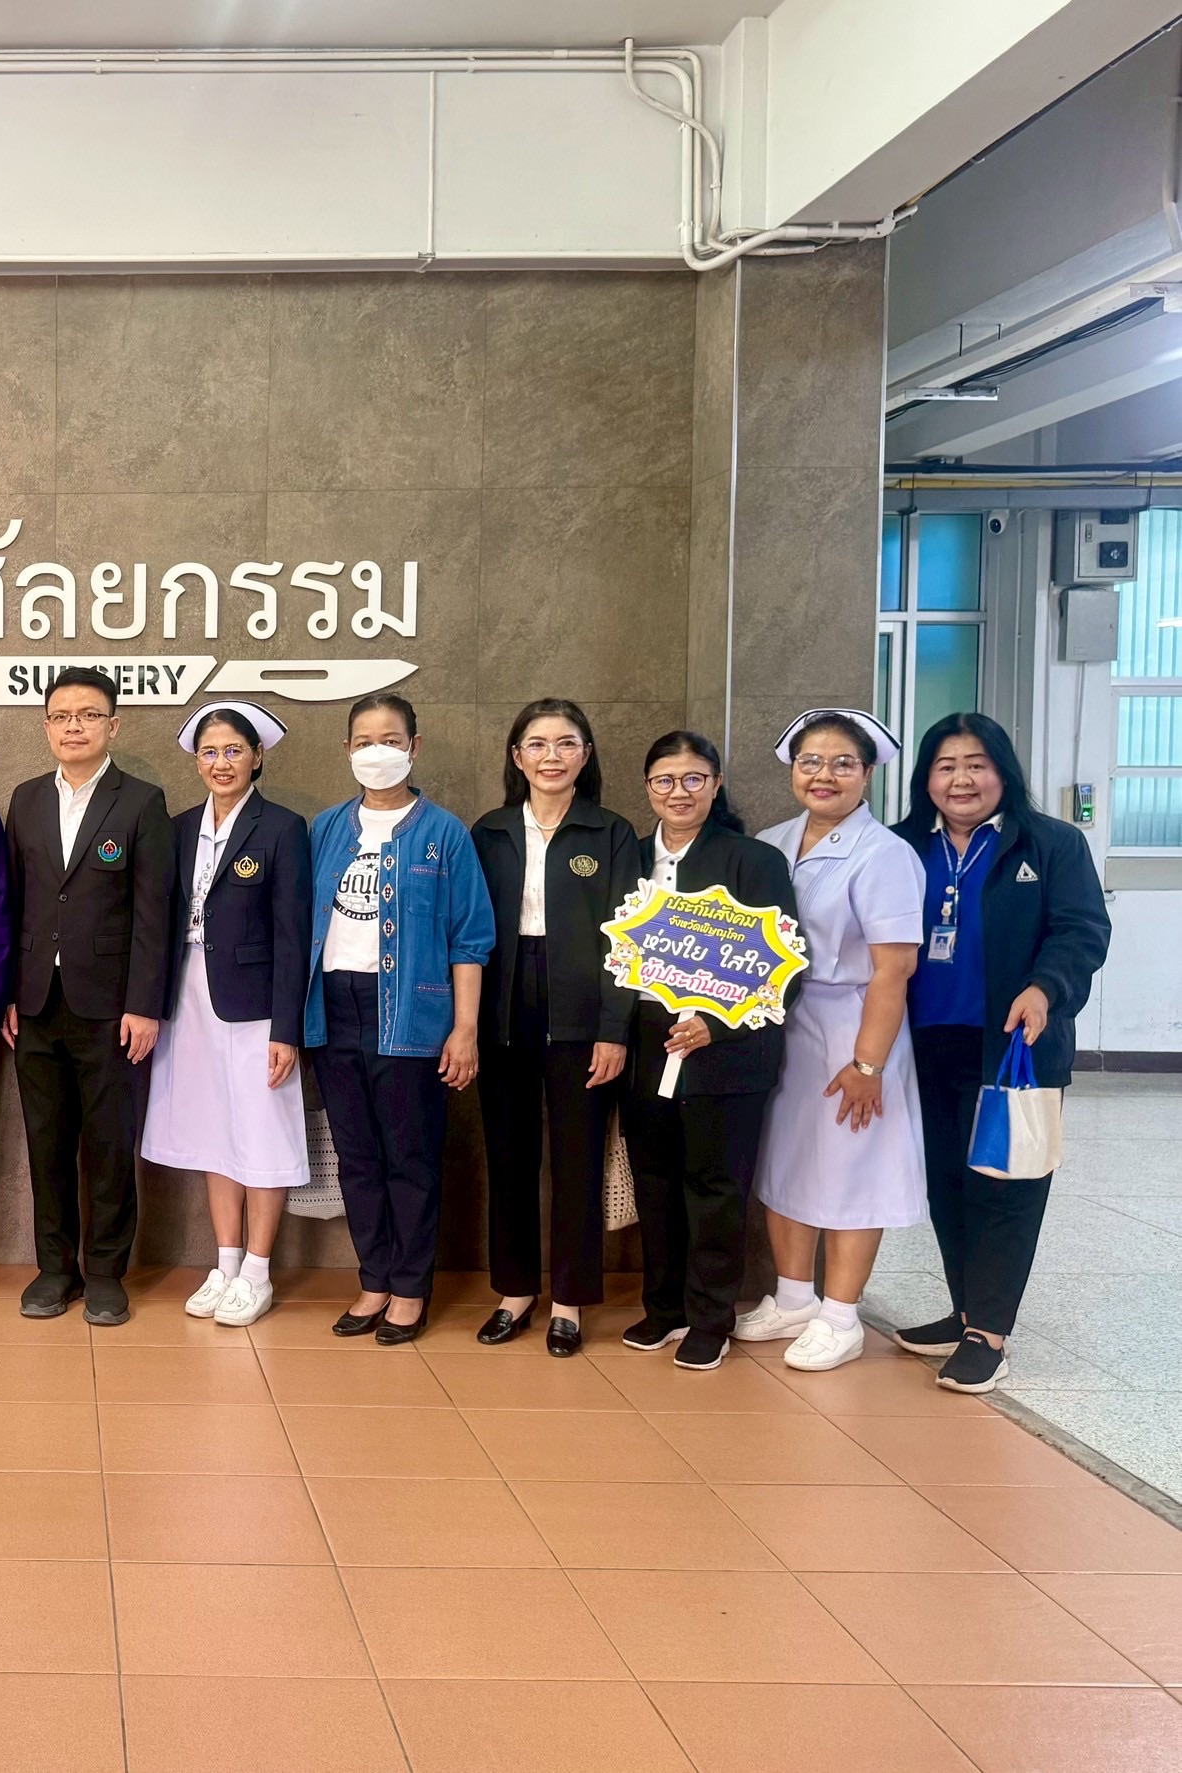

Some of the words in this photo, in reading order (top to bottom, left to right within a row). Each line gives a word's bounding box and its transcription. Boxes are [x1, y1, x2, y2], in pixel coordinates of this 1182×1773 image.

[8, 664, 186, 696] SUERY
[666, 896, 758, 929] ประกันสังคม
[668, 914, 745, 943] จังหวัดพิษณุโลก
[642, 929, 708, 961] ห่วงใย
[640, 959, 746, 1001] ผู้ประกันตน
